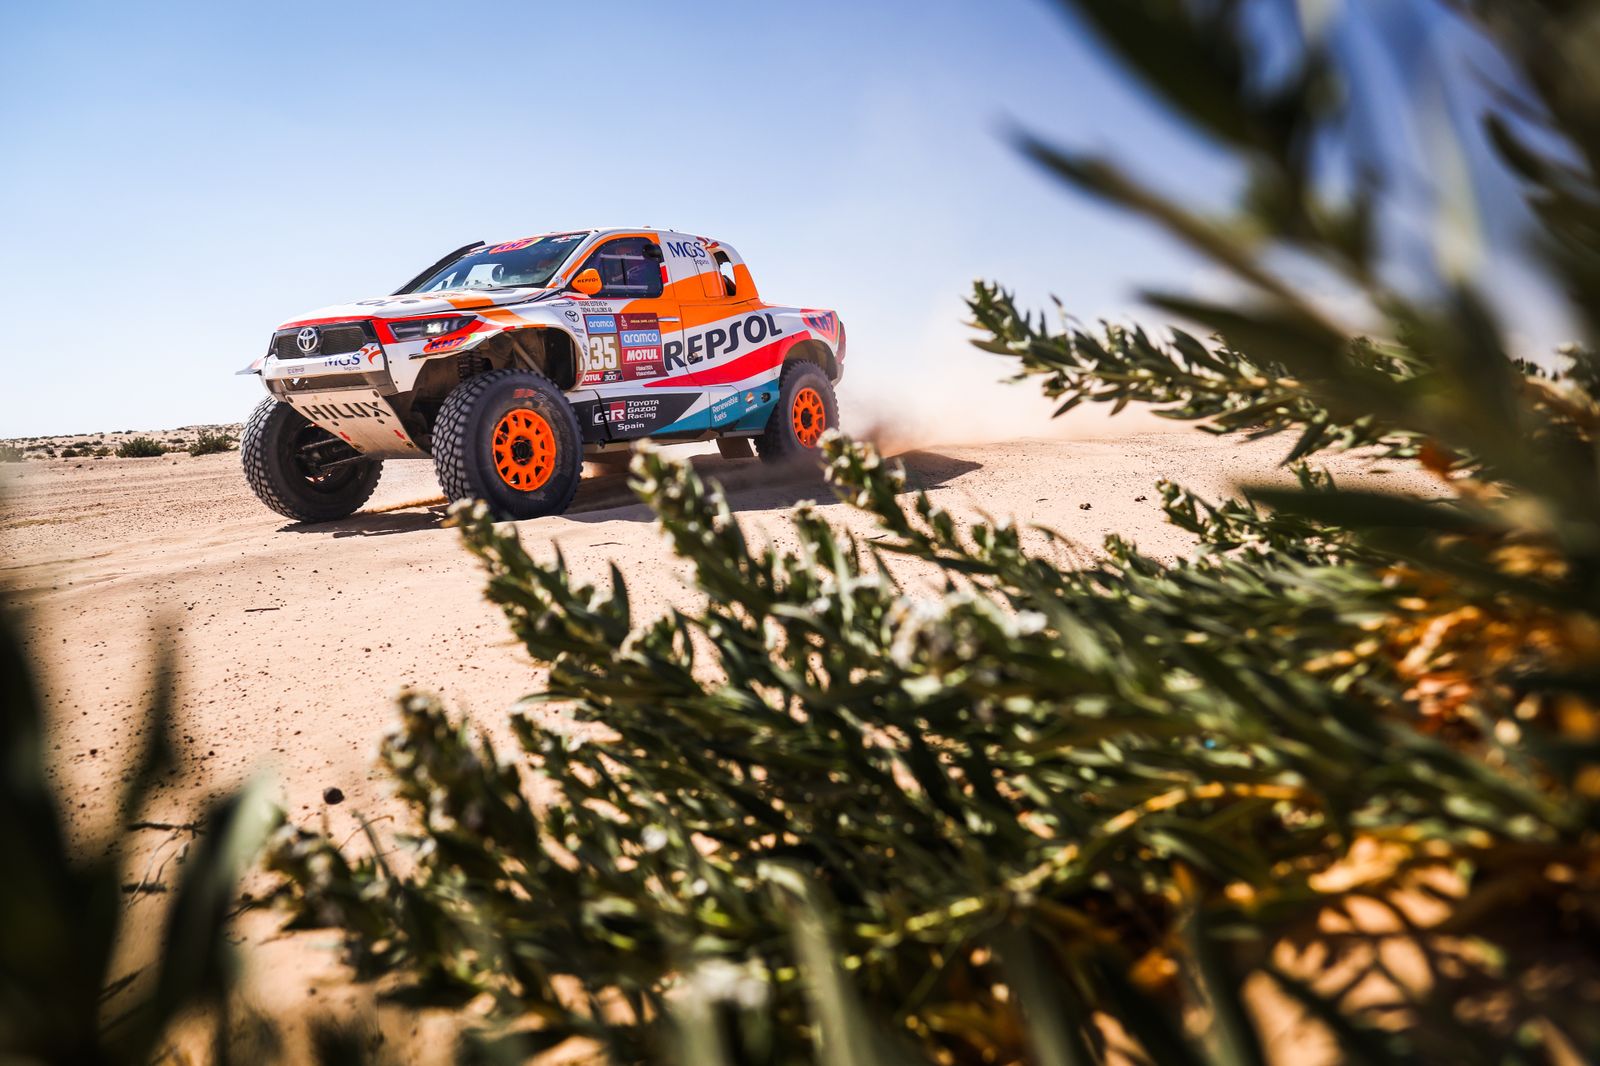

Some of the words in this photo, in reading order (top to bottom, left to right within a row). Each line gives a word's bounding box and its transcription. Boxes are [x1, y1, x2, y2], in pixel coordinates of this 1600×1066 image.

[666, 241, 706, 258] MGS
[588, 320, 615, 328] aramco
[623, 331, 658, 343] aramco
[663, 313, 783, 371] REPSOL
[324, 353, 361, 367] MGS
[626, 349, 658, 361] MOTUL
[582, 374, 602, 382] OTUL
[301, 401, 391, 421] HILUX
[712, 396, 739, 414] Renewable
[594, 409, 625, 424] GR
[627, 412, 656, 420] Racing
[713, 411, 727, 422] fuels
[617, 422, 645, 431] Spain
